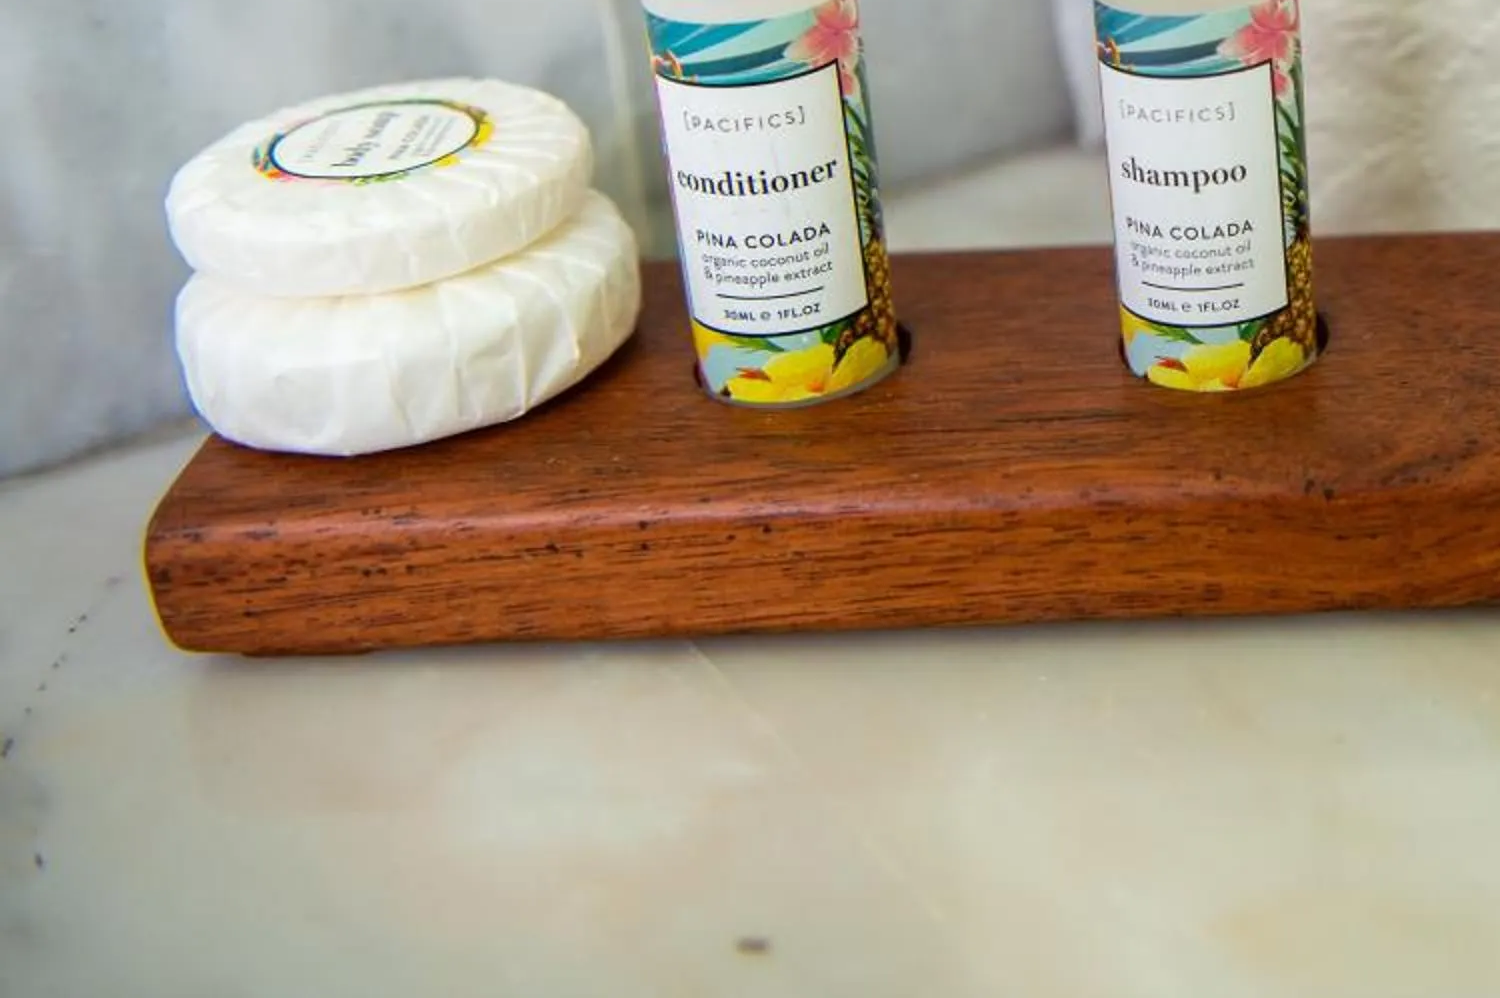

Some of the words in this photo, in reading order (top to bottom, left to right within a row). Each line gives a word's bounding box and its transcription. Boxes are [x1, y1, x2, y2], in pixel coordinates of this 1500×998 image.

[678, 160, 837, 196] conditioner
[1121, 157, 1247, 193] shampoo
[696, 230, 738, 249] PINA
[745, 223, 831, 249] COLADA
[1126, 216, 1163, 238] PINA
[1170, 220, 1253, 241] COLADA
[702, 253, 746, 270] organic
[752, 252, 810, 268] coconut
[814, 244, 829, 256] oil
[1131, 242, 1169, 259] organic
[1175, 247, 1231, 259] coconut
[1235, 241, 1250, 255] oil
[705, 266, 713, 279] &
[716, 271, 779, 289] pineapple
[784, 262, 833, 280] extract
[1132, 255, 1139, 266] &
[1142, 262, 1201, 279] pineapple
[1206, 259, 1255, 273] extract
